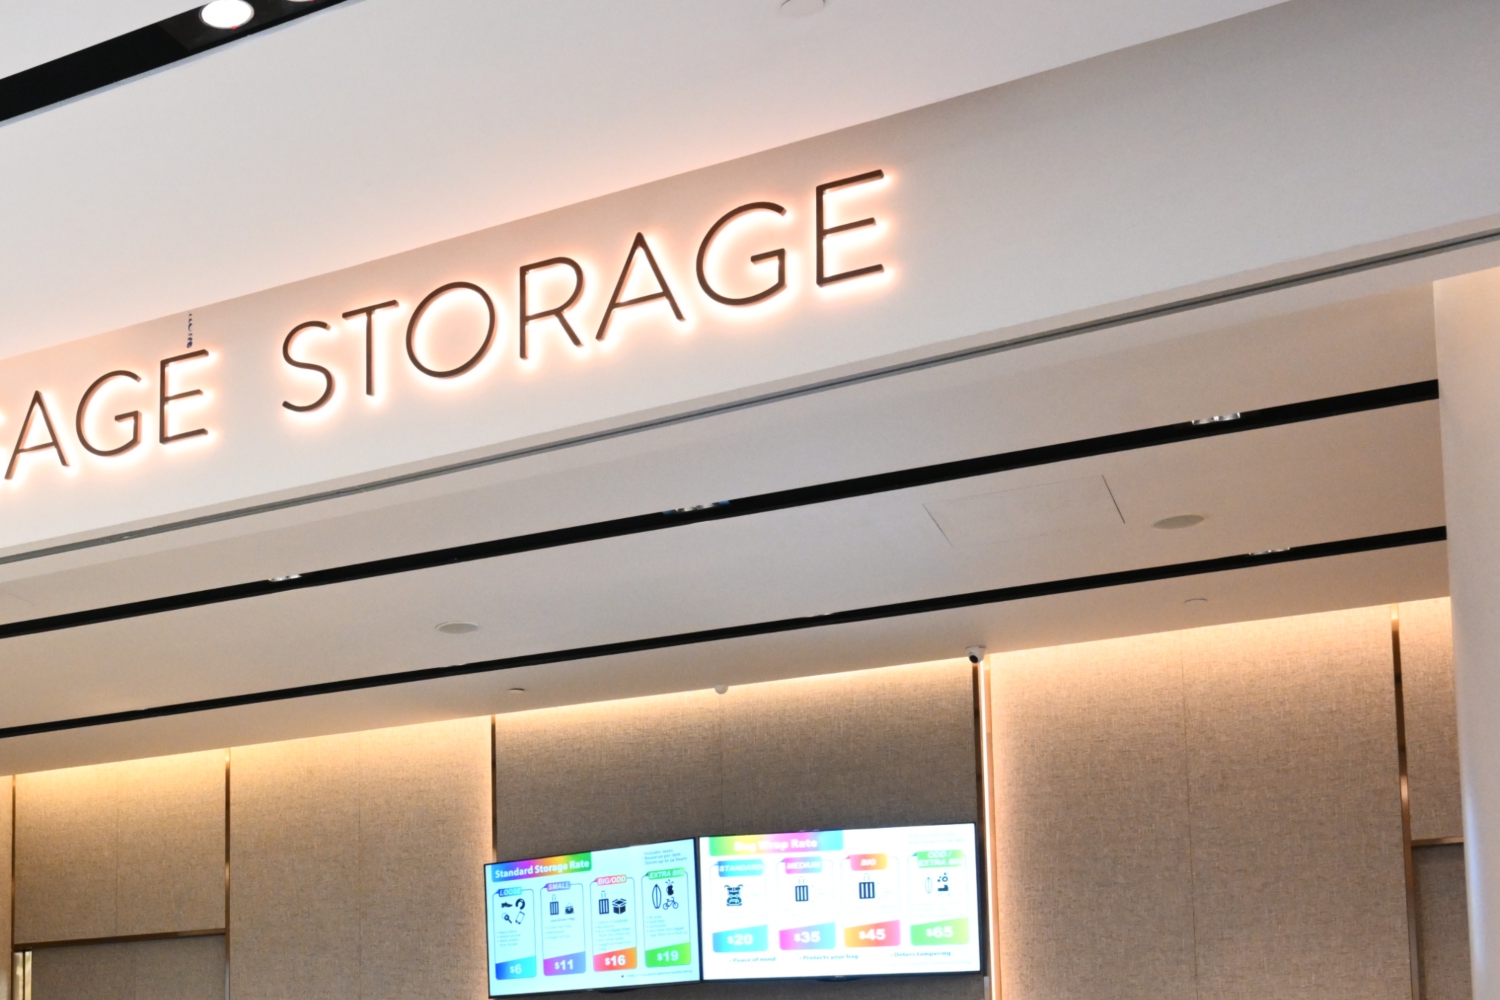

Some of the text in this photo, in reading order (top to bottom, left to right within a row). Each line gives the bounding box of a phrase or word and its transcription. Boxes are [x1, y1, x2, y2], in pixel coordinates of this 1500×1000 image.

[279, 167, 886, 415] STORAGE
[758, 839, 789, 852] Wrap
[791, 838, 818, 849] Rate
[494, 860, 590, 879] Standard Storage Rate
[649, 870, 671, 879] EXTRA
[548, 881, 570, 891] SMALL
[598, 875, 627, 885] BIG/ODD
[499, 887, 522, 896] LOOSE
[793, 931, 821, 943] $35
[858, 928, 886, 941] $45
[925, 926, 954, 938] $65
[726, 933, 753, 946] $20
[604, 955, 626, 967] $16
[657, 950, 679, 963] $19
[509, 963, 522, 974] $6
[554, 959, 574, 971] $11
